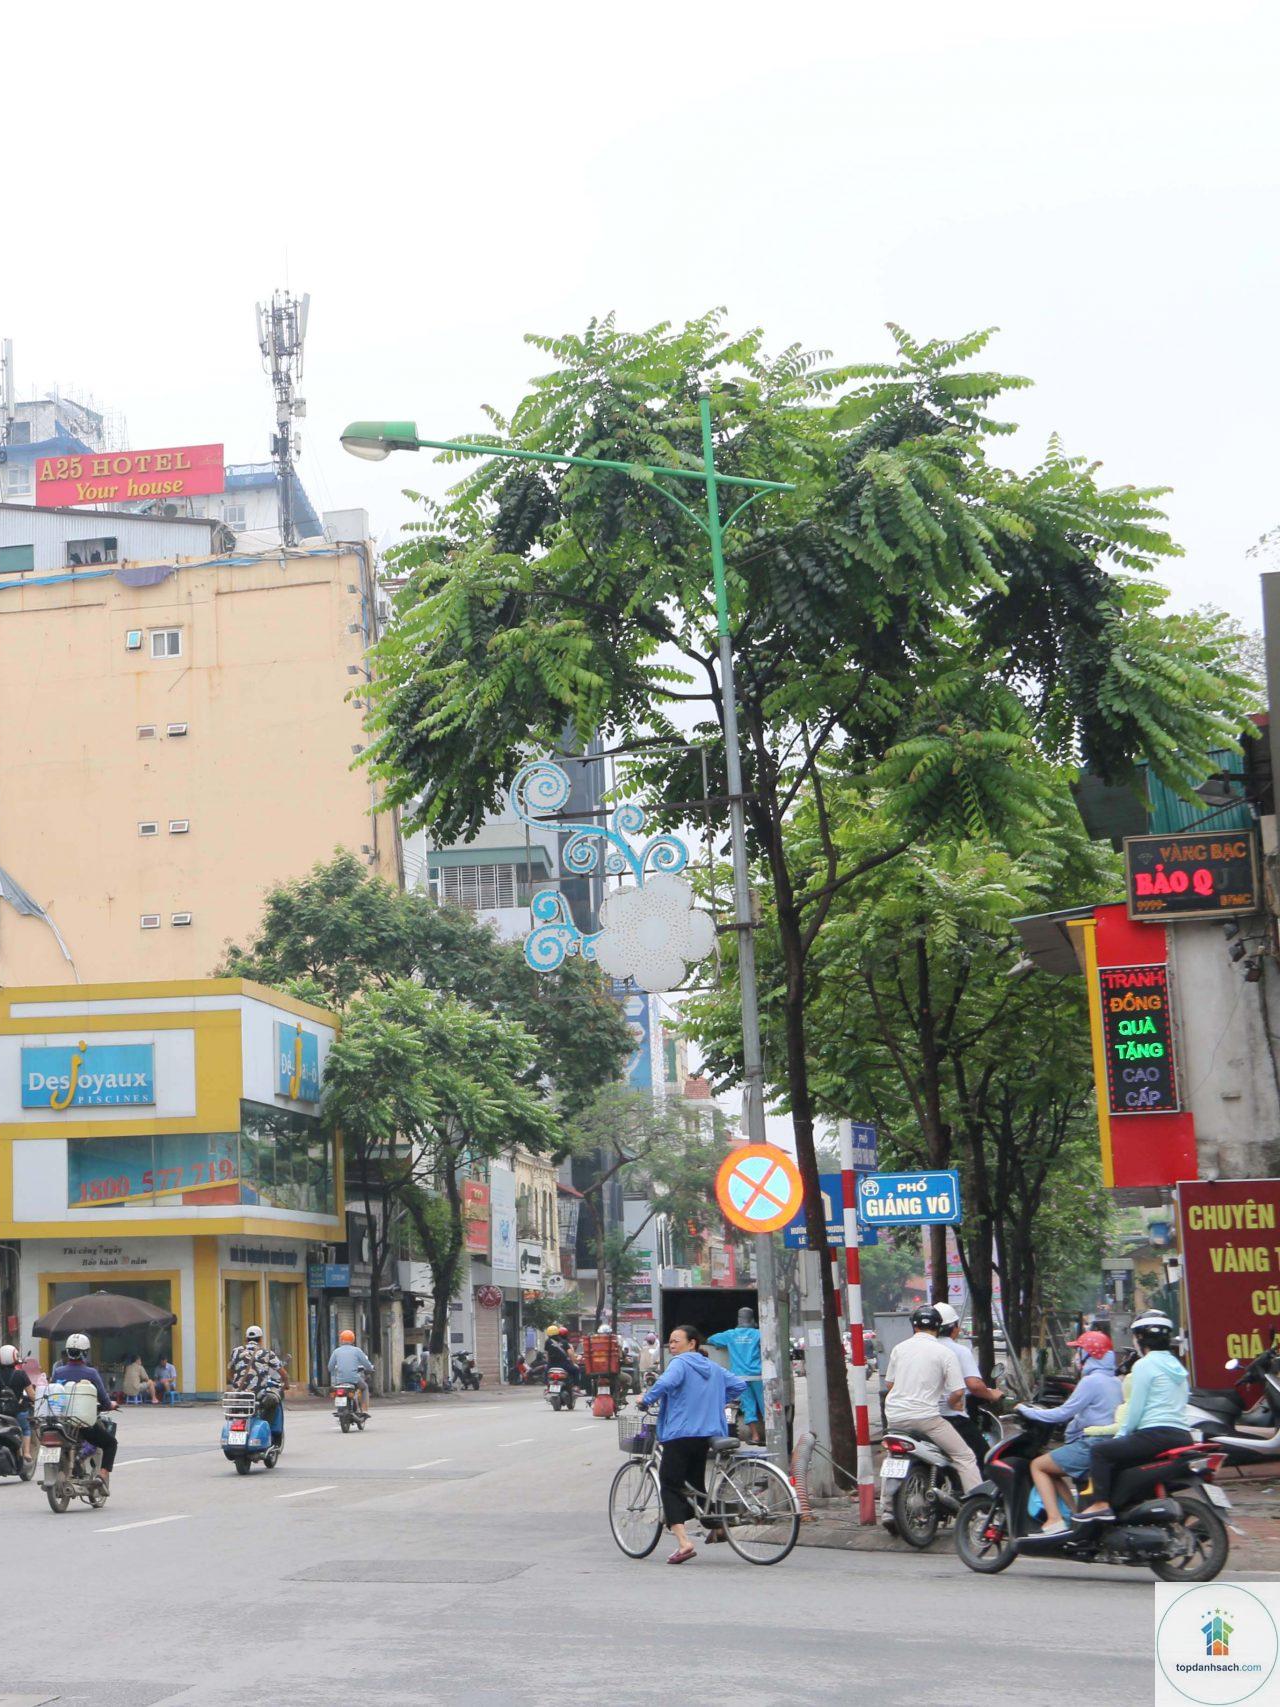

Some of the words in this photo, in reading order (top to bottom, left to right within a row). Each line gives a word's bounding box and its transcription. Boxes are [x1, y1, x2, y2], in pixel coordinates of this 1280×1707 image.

[40, 457, 83, 481] A25
[91, 452, 192, 477] HOTEL
[76, 482, 118, 501] Your
[127, 478, 184, 497] house
[1159, 843, 1207, 862] VÀNG
[1210, 841, 1247, 862] BẠC
[1134, 863, 1190, 896] BẢO
[1105, 972, 1163, 988] TRANH
[1110, 992, 1161, 1012] ĐỒNG
[1118, 1016, 1157, 1036] QUÀ
[1115, 1041, 1164, 1061] TẶNG
[28, 1040, 148, 1111] Desjoyaux
[1122, 1067, 1160, 1083] CAO
[78, 1094, 149, 1104] PISCINES
[1125, 1086, 1161, 1107] CẤP
[80, 1175, 130, 1203] 1800
[142, 1167, 184, 1193] 577
[192, 1159, 234, 1185] 719
[897, 1178, 927, 1193] PHỐ
[866, 1193, 922, 1217] GIẢNG
[926, 1193, 951, 1214] VÕ
[1188, 1199, 1275, 1231] CHUYÊN
[1209, 1243, 1270, 1273] VÀNG
[1227, 1331, 1264, 1359] GIÁ
